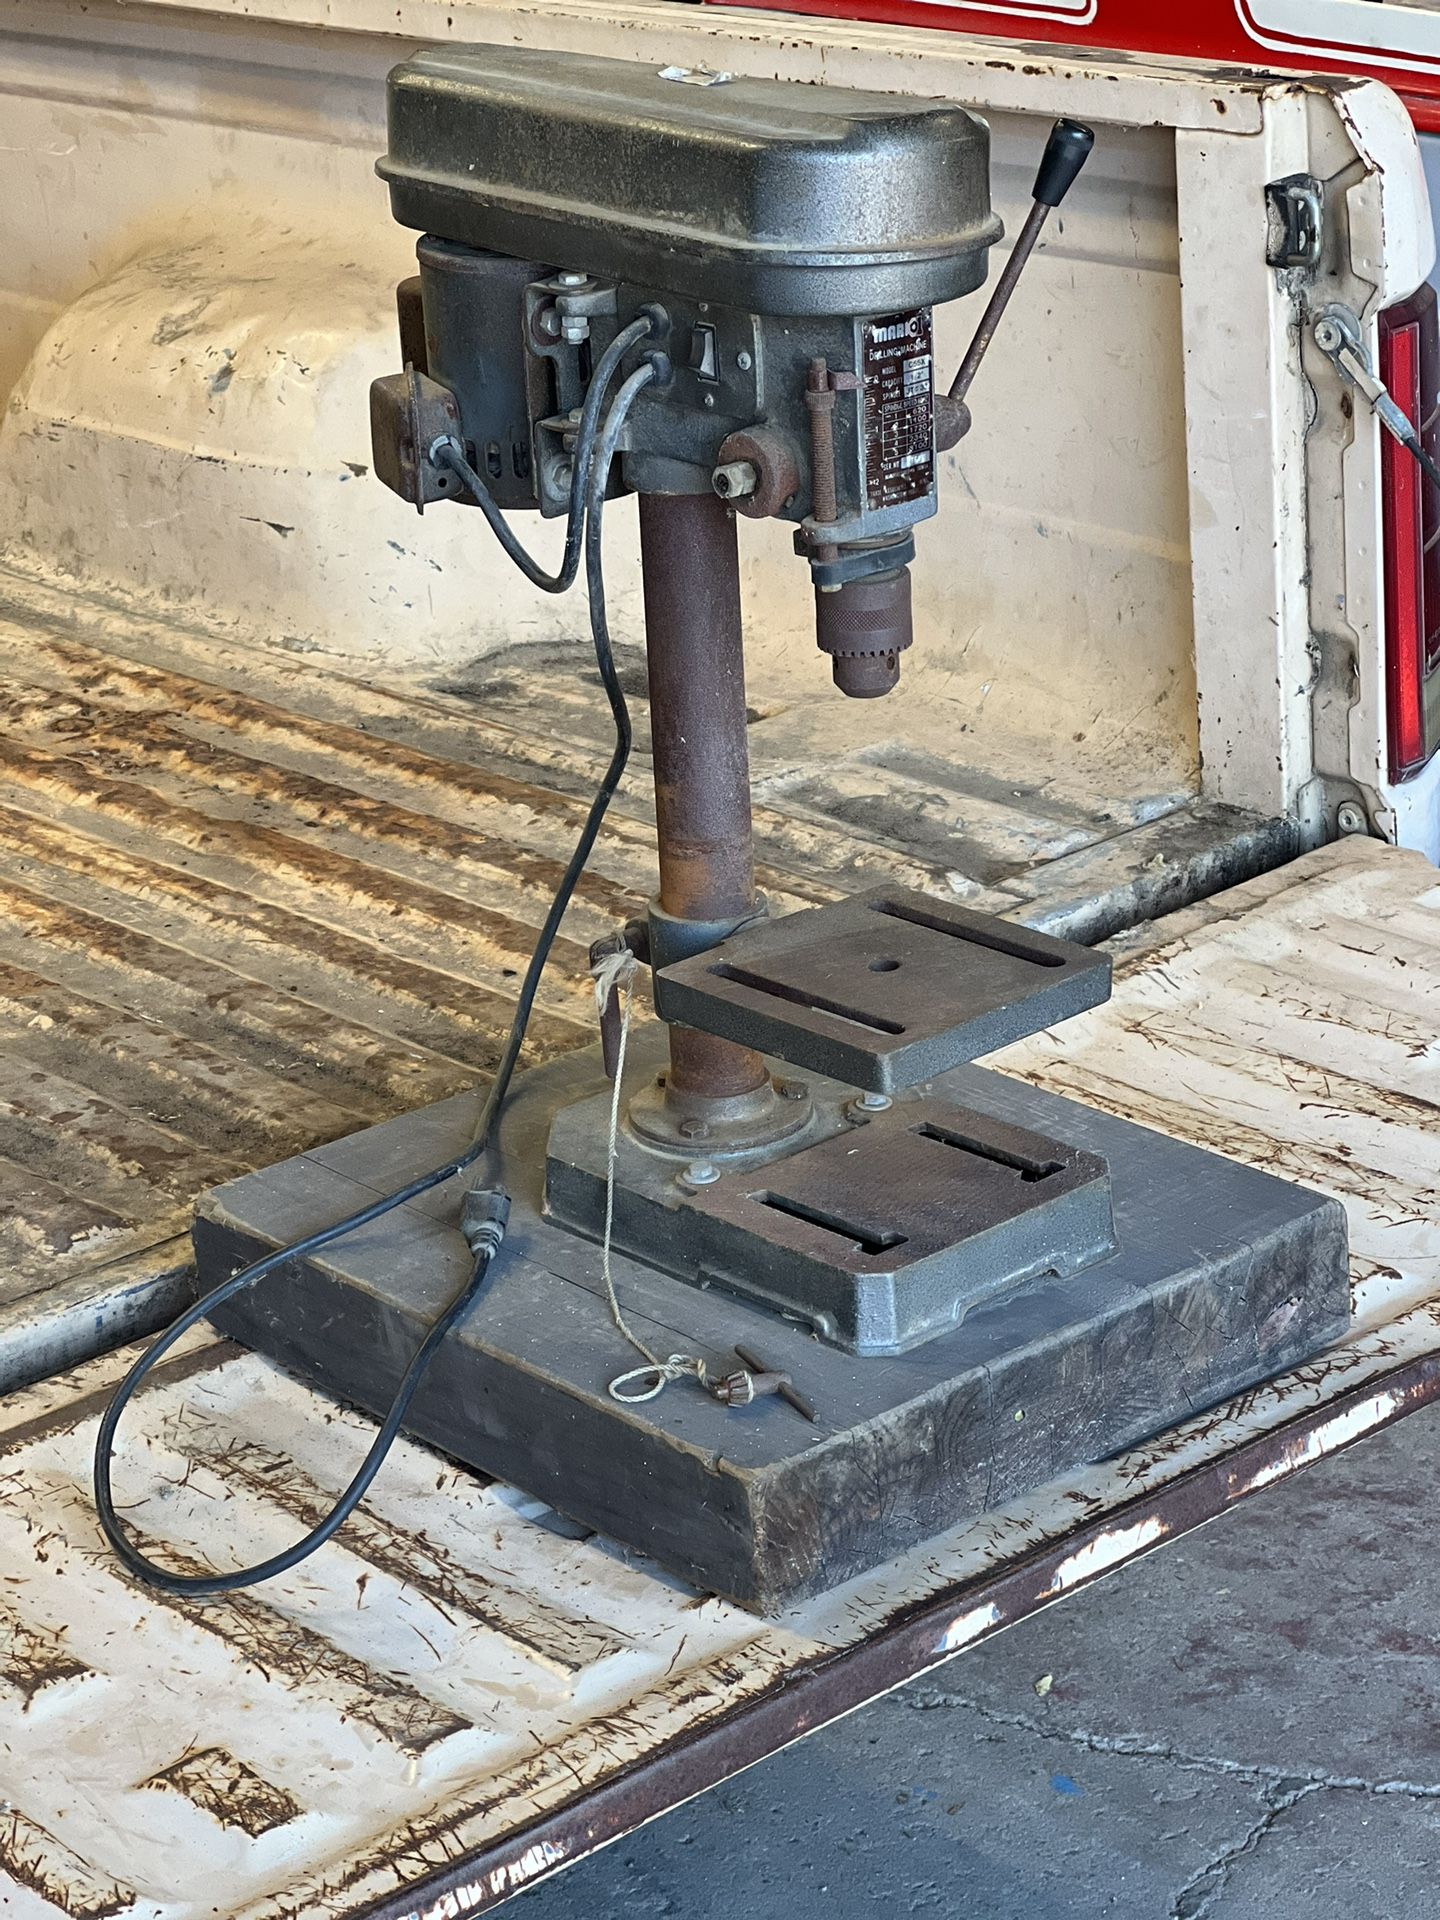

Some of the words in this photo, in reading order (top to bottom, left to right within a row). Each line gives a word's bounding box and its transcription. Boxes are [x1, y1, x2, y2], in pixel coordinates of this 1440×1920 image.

[912, 405, 927, 414] 620
[909, 423, 928, 433] 1720
[909, 432, 928, 442] 2340
